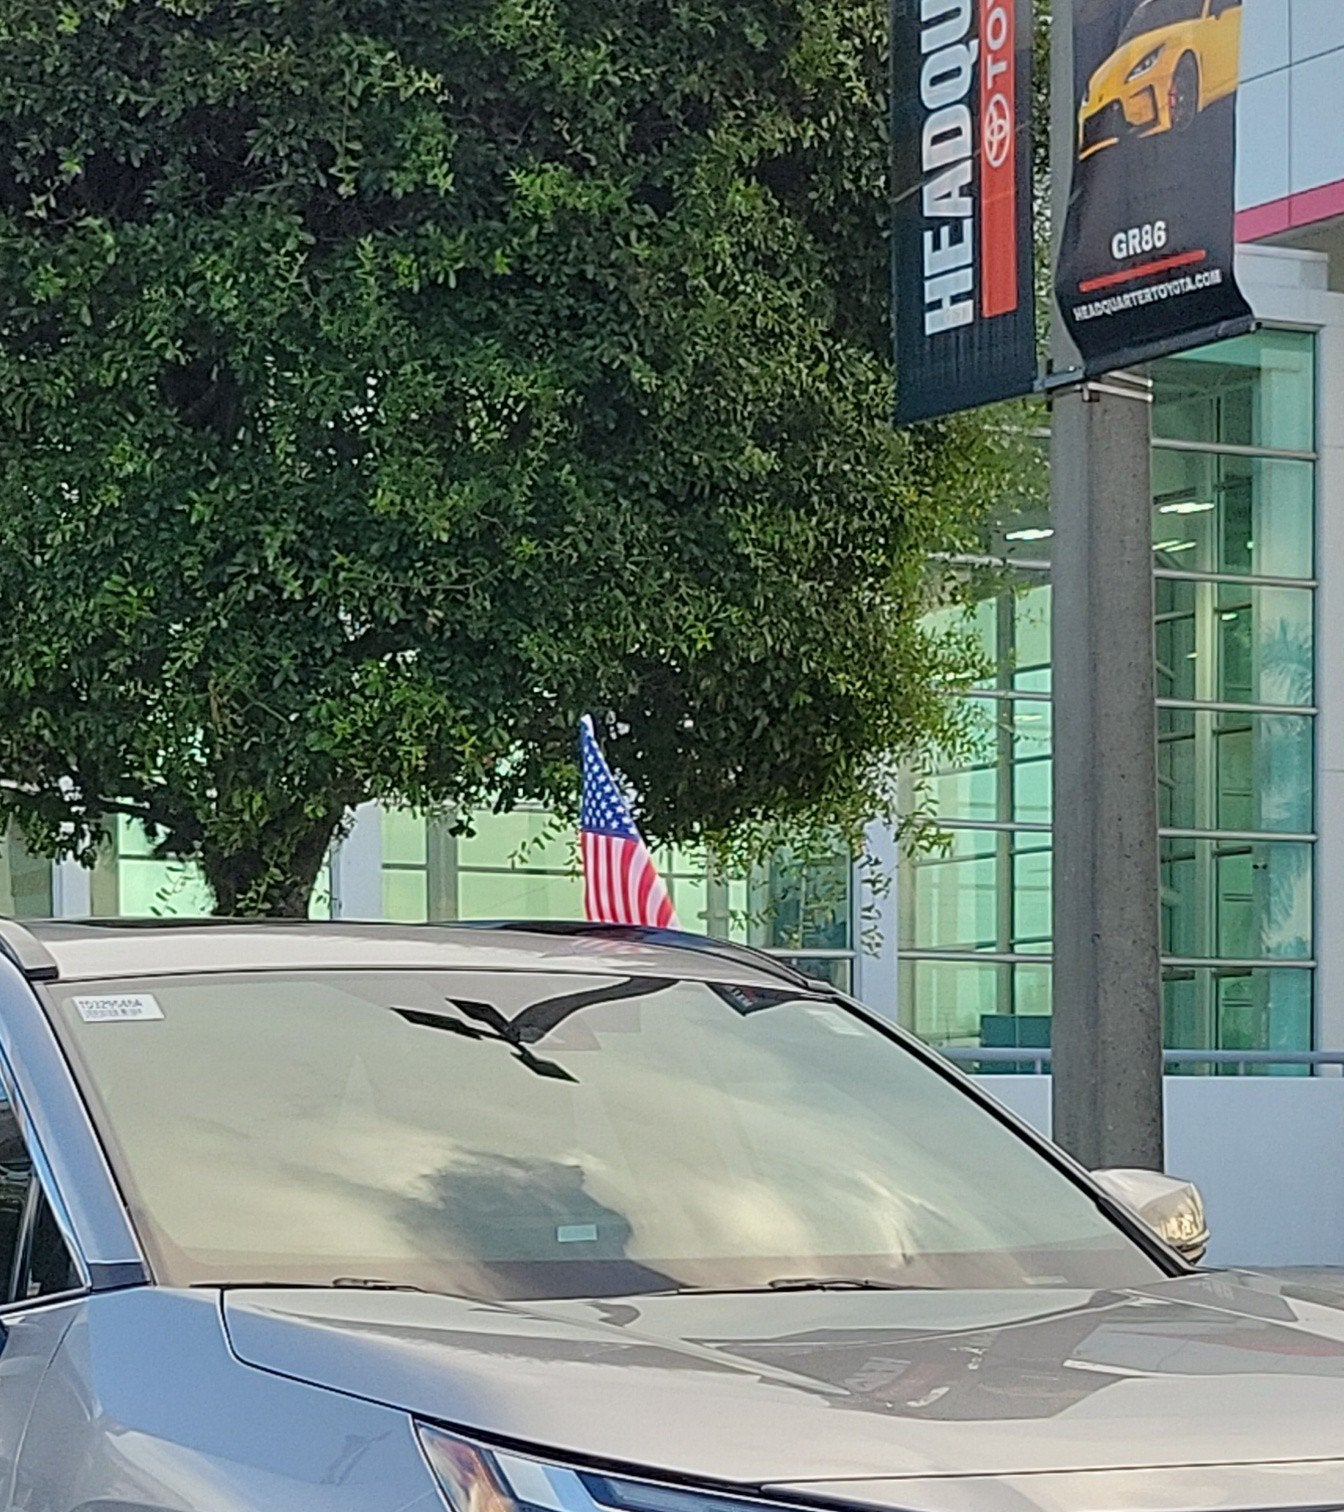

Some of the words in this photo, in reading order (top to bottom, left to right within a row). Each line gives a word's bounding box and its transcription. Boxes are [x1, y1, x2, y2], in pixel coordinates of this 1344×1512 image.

[985, 0, 1008, 90] TO
[1111, 220, 1167, 260] GR86
[1072, 268, 1223, 321] HEADQUARTERTOYOTA.COM
